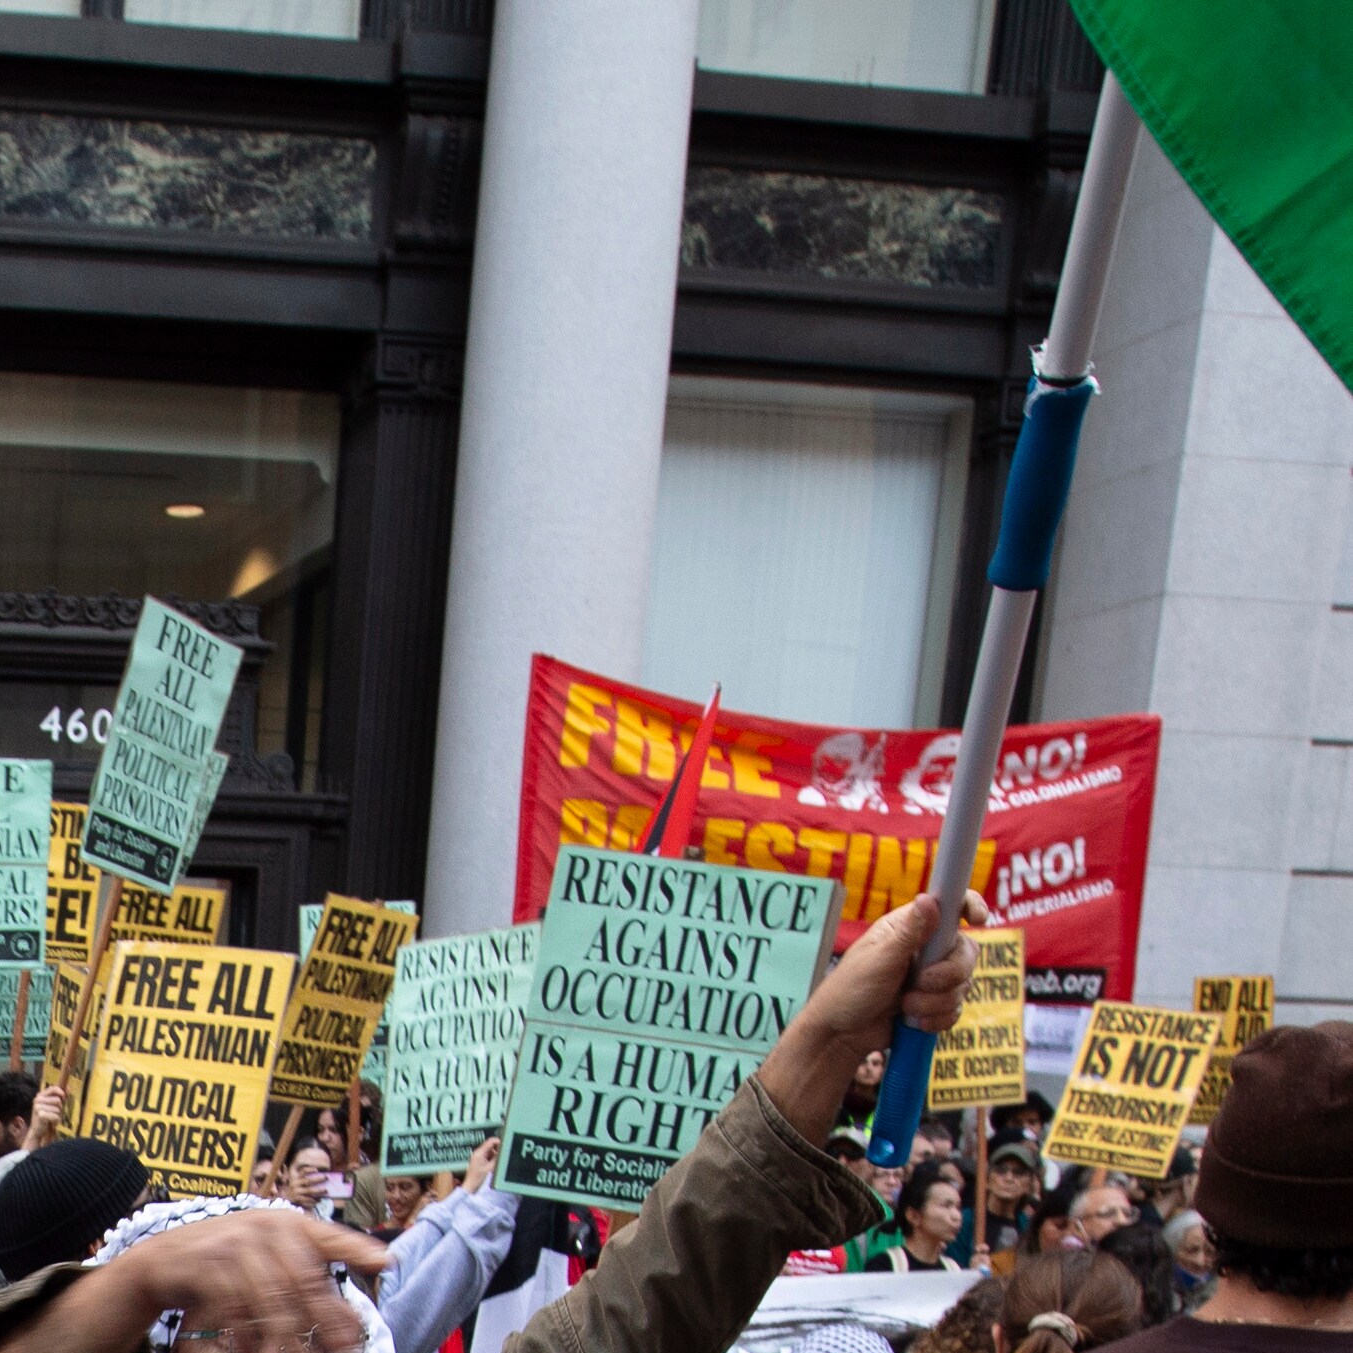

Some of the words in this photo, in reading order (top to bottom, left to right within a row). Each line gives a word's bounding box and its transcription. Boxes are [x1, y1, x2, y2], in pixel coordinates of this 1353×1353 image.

[155, 614, 219, 680] FREE
[155, 662, 195, 712] ALL
[40, 706, 113, 743] 460
[111, 737, 191, 803] POLITICAL
[1010, 765, 1123, 808] COLONIALISMO
[560, 854, 818, 934] RESISTANCE
[997, 836, 1086, 909] ¡NO!
[174, 896, 213, 933] ALL
[1007, 878, 1115, 921] IMPERIALISMO
[317, 907, 374, 959] FREE
[400, 930, 535, 984] RESISTANCE
[583, 915, 772, 984] AGAINST
[115, 954, 204, 1012] FREE
[207, 961, 275, 1021] ALL
[416, 970, 515, 1016] AGAINST
[541, 964, 795, 1042] OCCUPATION
[1200, 979, 1231, 1012] END
[1238, 978, 1269, 1011] ALL
[105, 1013, 271, 1069] PALESTINIAN
[979, 1024, 1020, 1048] PEOPLE
[1095, 1005, 1216, 1044] RESISTANCE
[414, 1065, 427, 1091] A
[434, 1051, 519, 1088] HUMA
[528, 1034, 566, 1077] IS
[569, 1042, 599, 1084] A
[610, 1040, 763, 1103] HUMA
[934, 1056, 960, 1080] ARE
[1081, 1034, 1119, 1079] IS
[1120, 1040, 1201, 1092] NOT
[107, 1070, 237, 1125] POLITICAL
[1066, 1089, 1187, 1128] TERRORISM!
[91, 1112, 247, 1172] PRISONERS!
[1056, 1119, 1091, 1139] FREE
[521, 1139, 569, 1168] Party
[572, 1147, 597, 1169] for
[536, 1167, 570, 1188] and
[168, 1174, 237, 1198] Coalition
